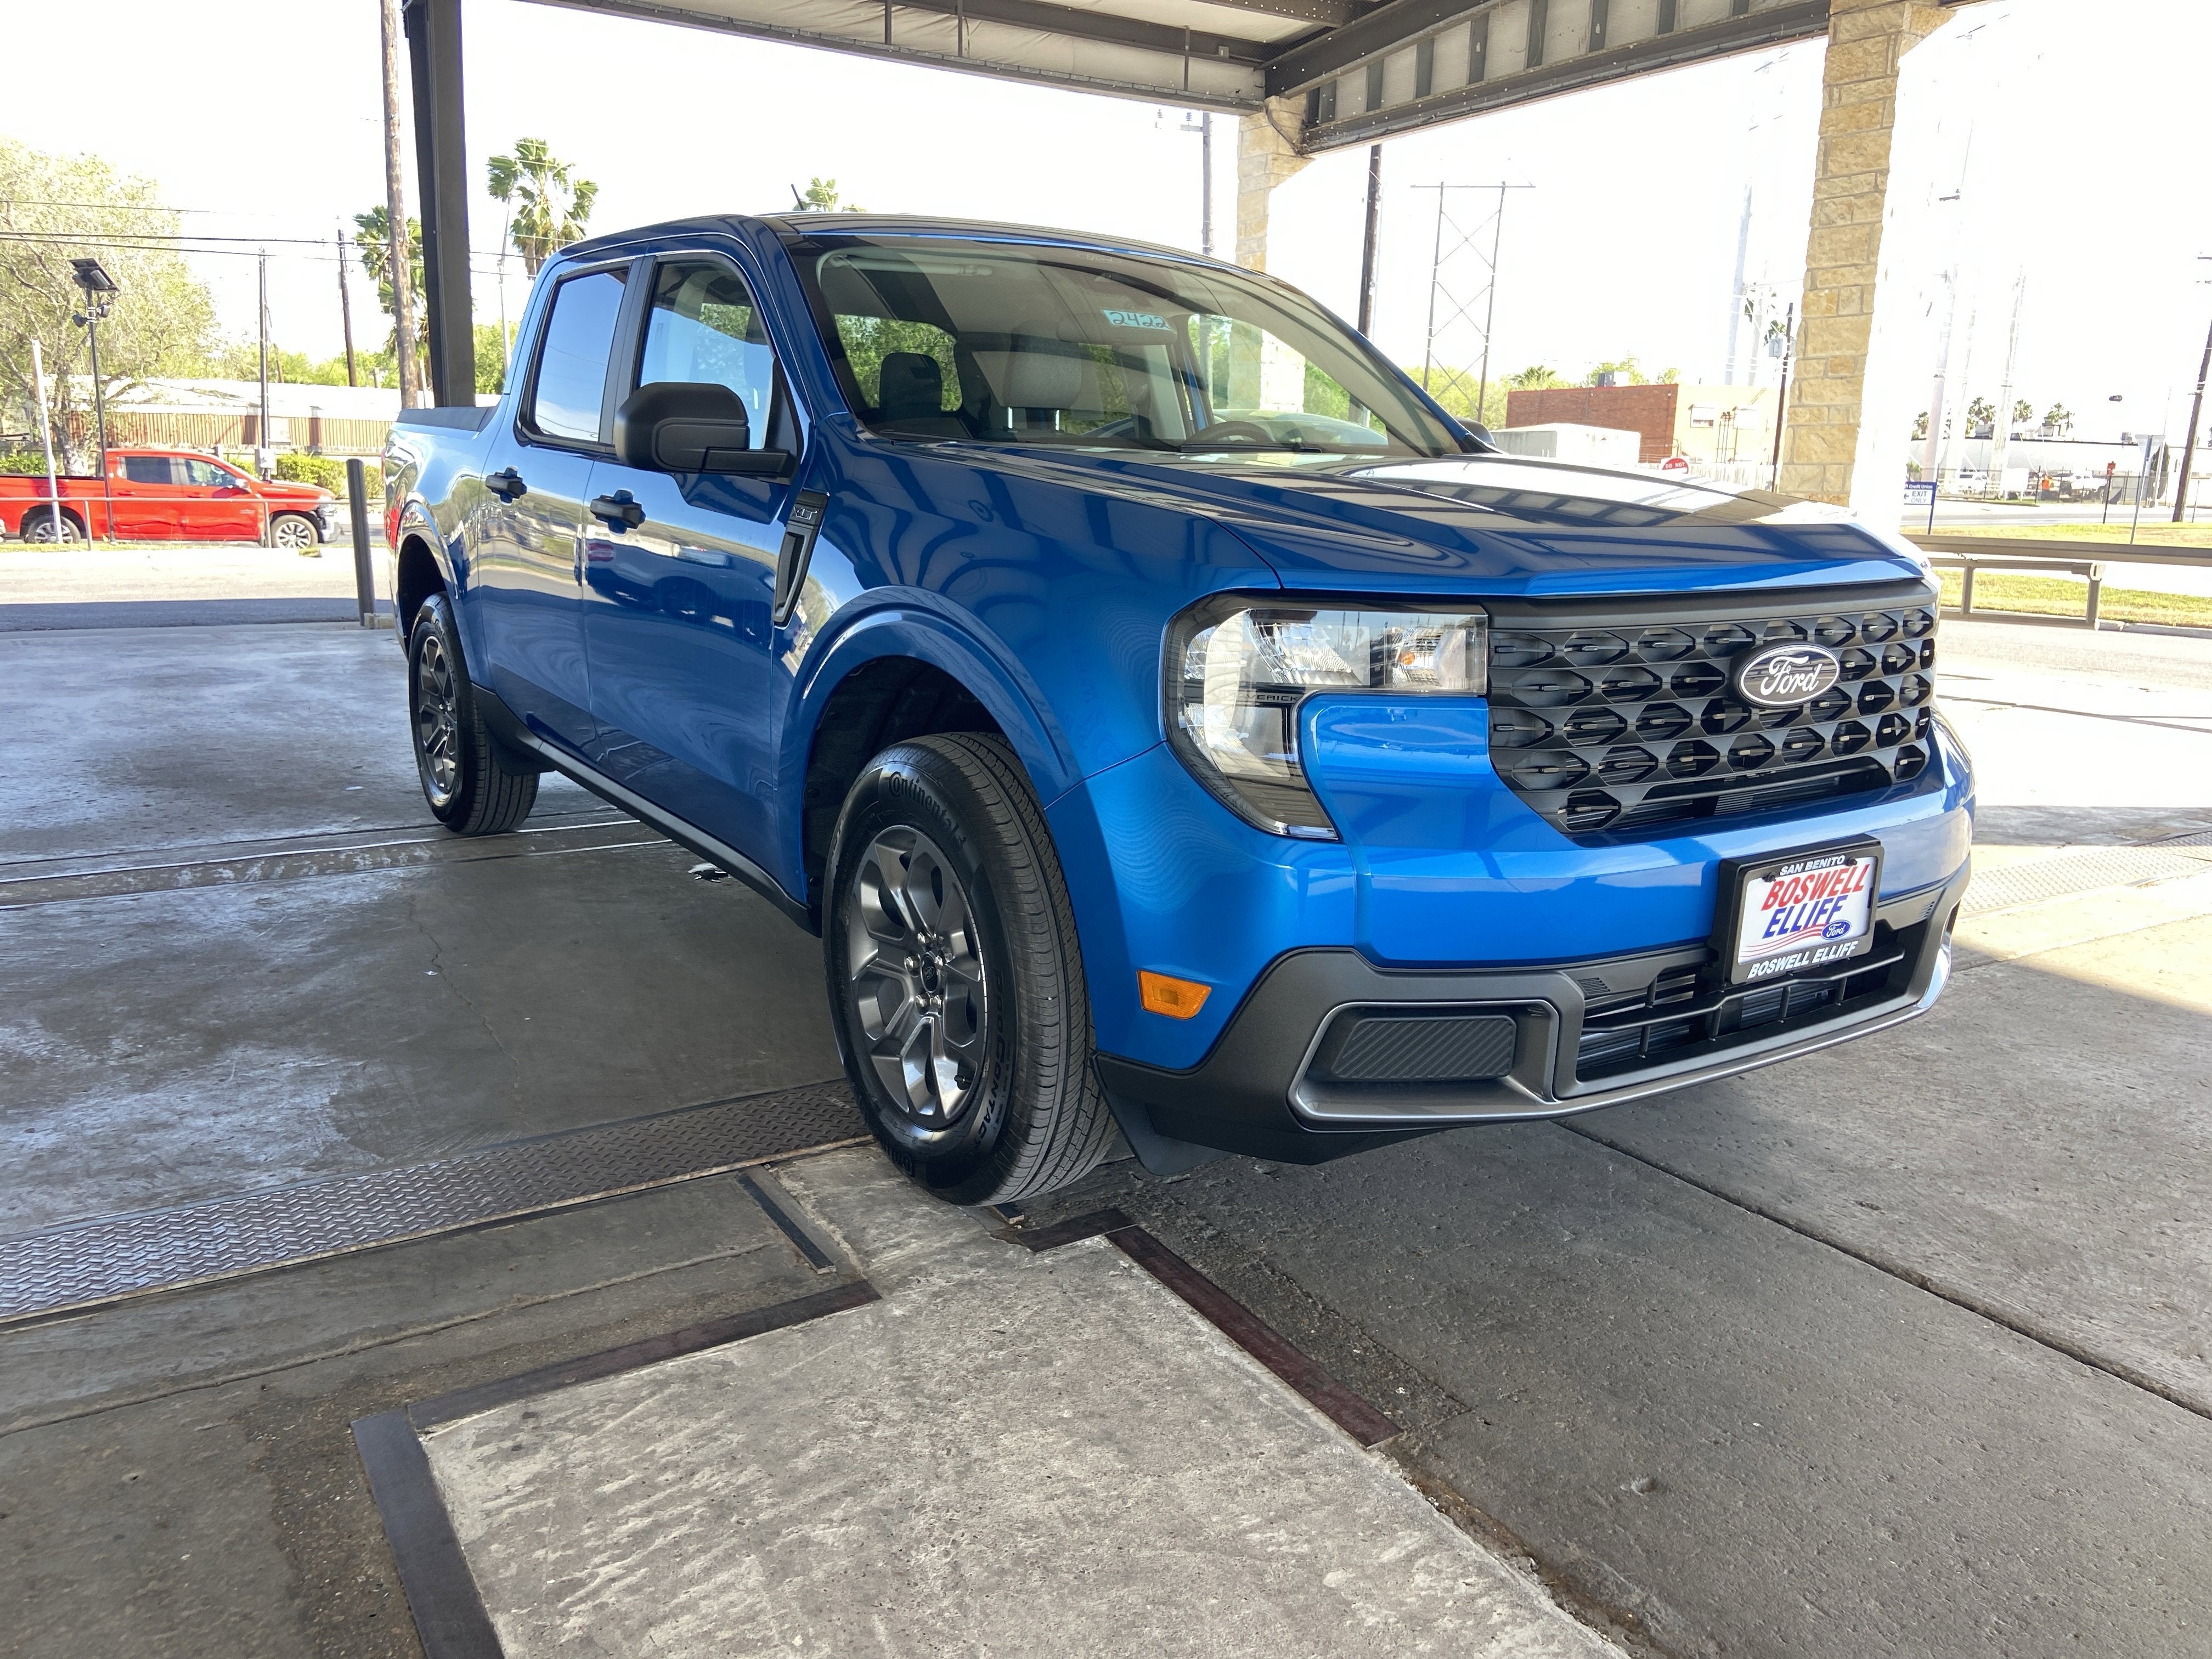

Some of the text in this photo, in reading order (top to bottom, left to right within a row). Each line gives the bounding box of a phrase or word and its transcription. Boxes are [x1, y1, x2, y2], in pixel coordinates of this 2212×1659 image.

[1110, 312, 1171, 329] 2422
[793, 506, 817, 520] XLT
[1760, 656, 1822, 696] Ford
[889, 771, 960, 840] Continental
[1779, 855, 1846, 876] SAN BENITO
[1760, 864, 1870, 911] BOSWELL
[1762, 895, 1848, 939] ELLIFF
[1826, 923, 1846, 938] Ford
[1747, 940, 1859, 979] BOSWELL ELLIFF
